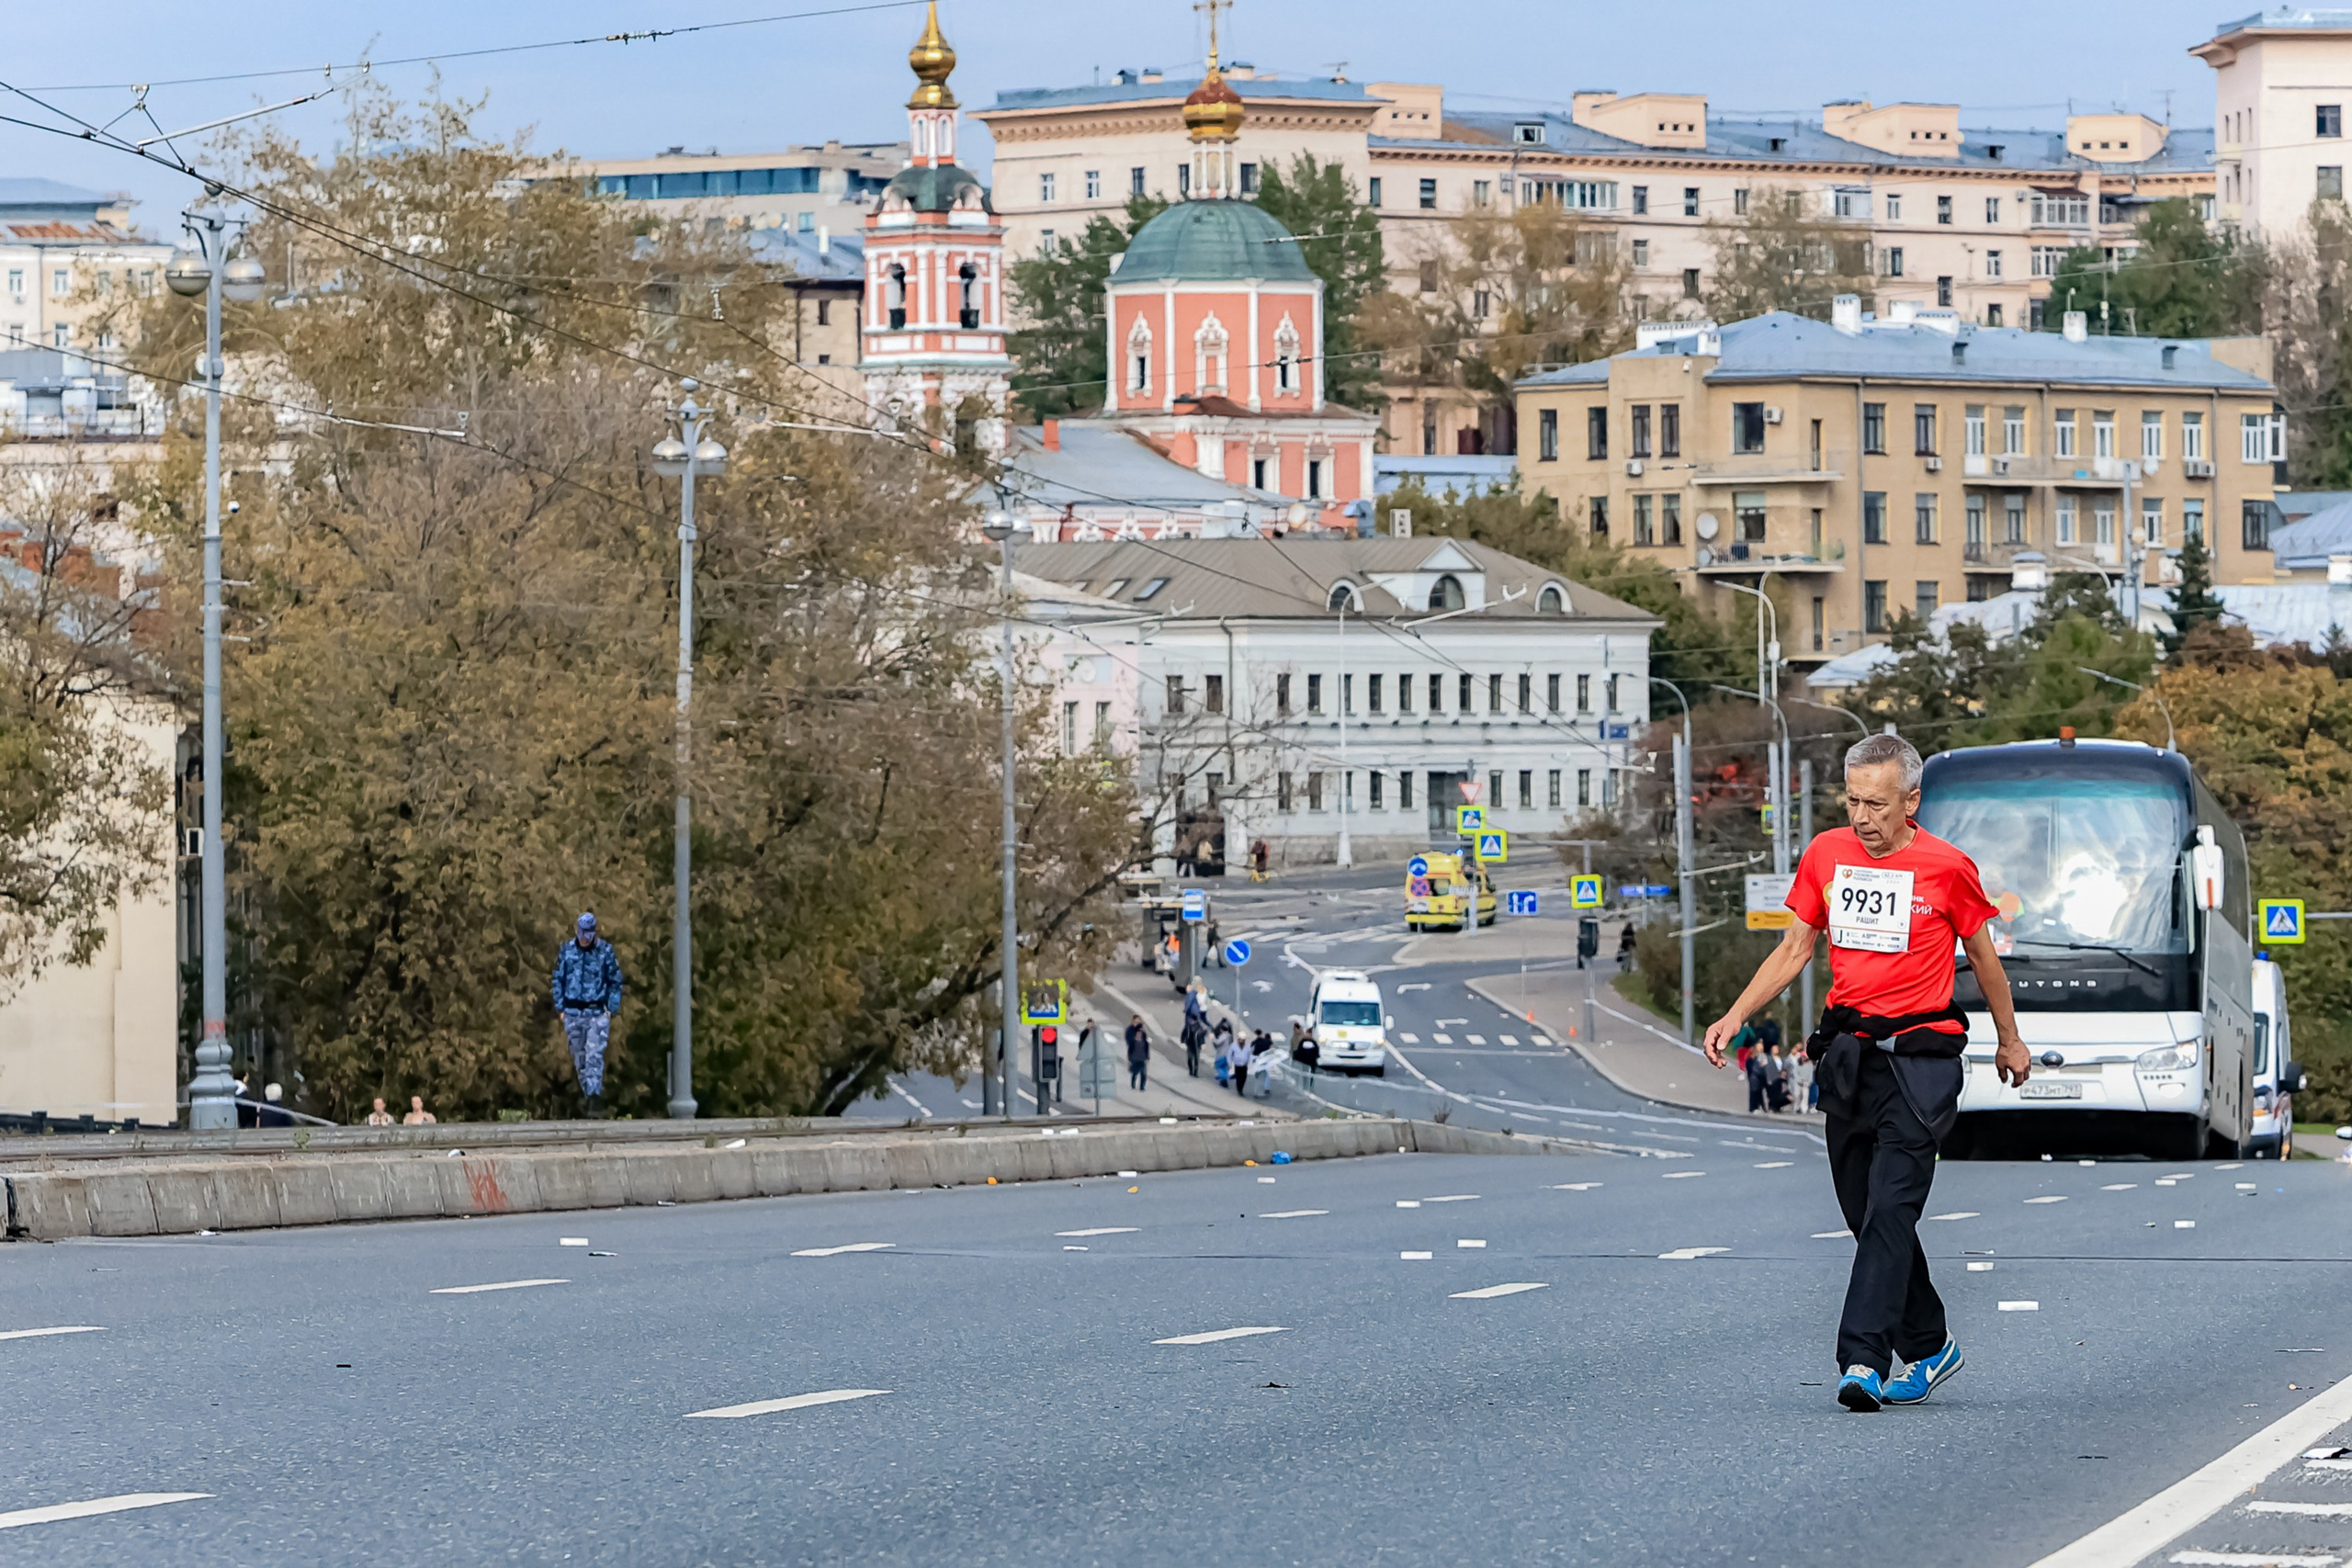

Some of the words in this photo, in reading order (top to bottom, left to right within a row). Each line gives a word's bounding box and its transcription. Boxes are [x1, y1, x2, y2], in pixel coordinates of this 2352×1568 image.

[1841, 887, 1896, 916] 9931
[1912, 895, 1925, 903] НК
[1911, 904, 1933, 916] КИЙ
[1856, 916, 1879, 925] РАШИТ
